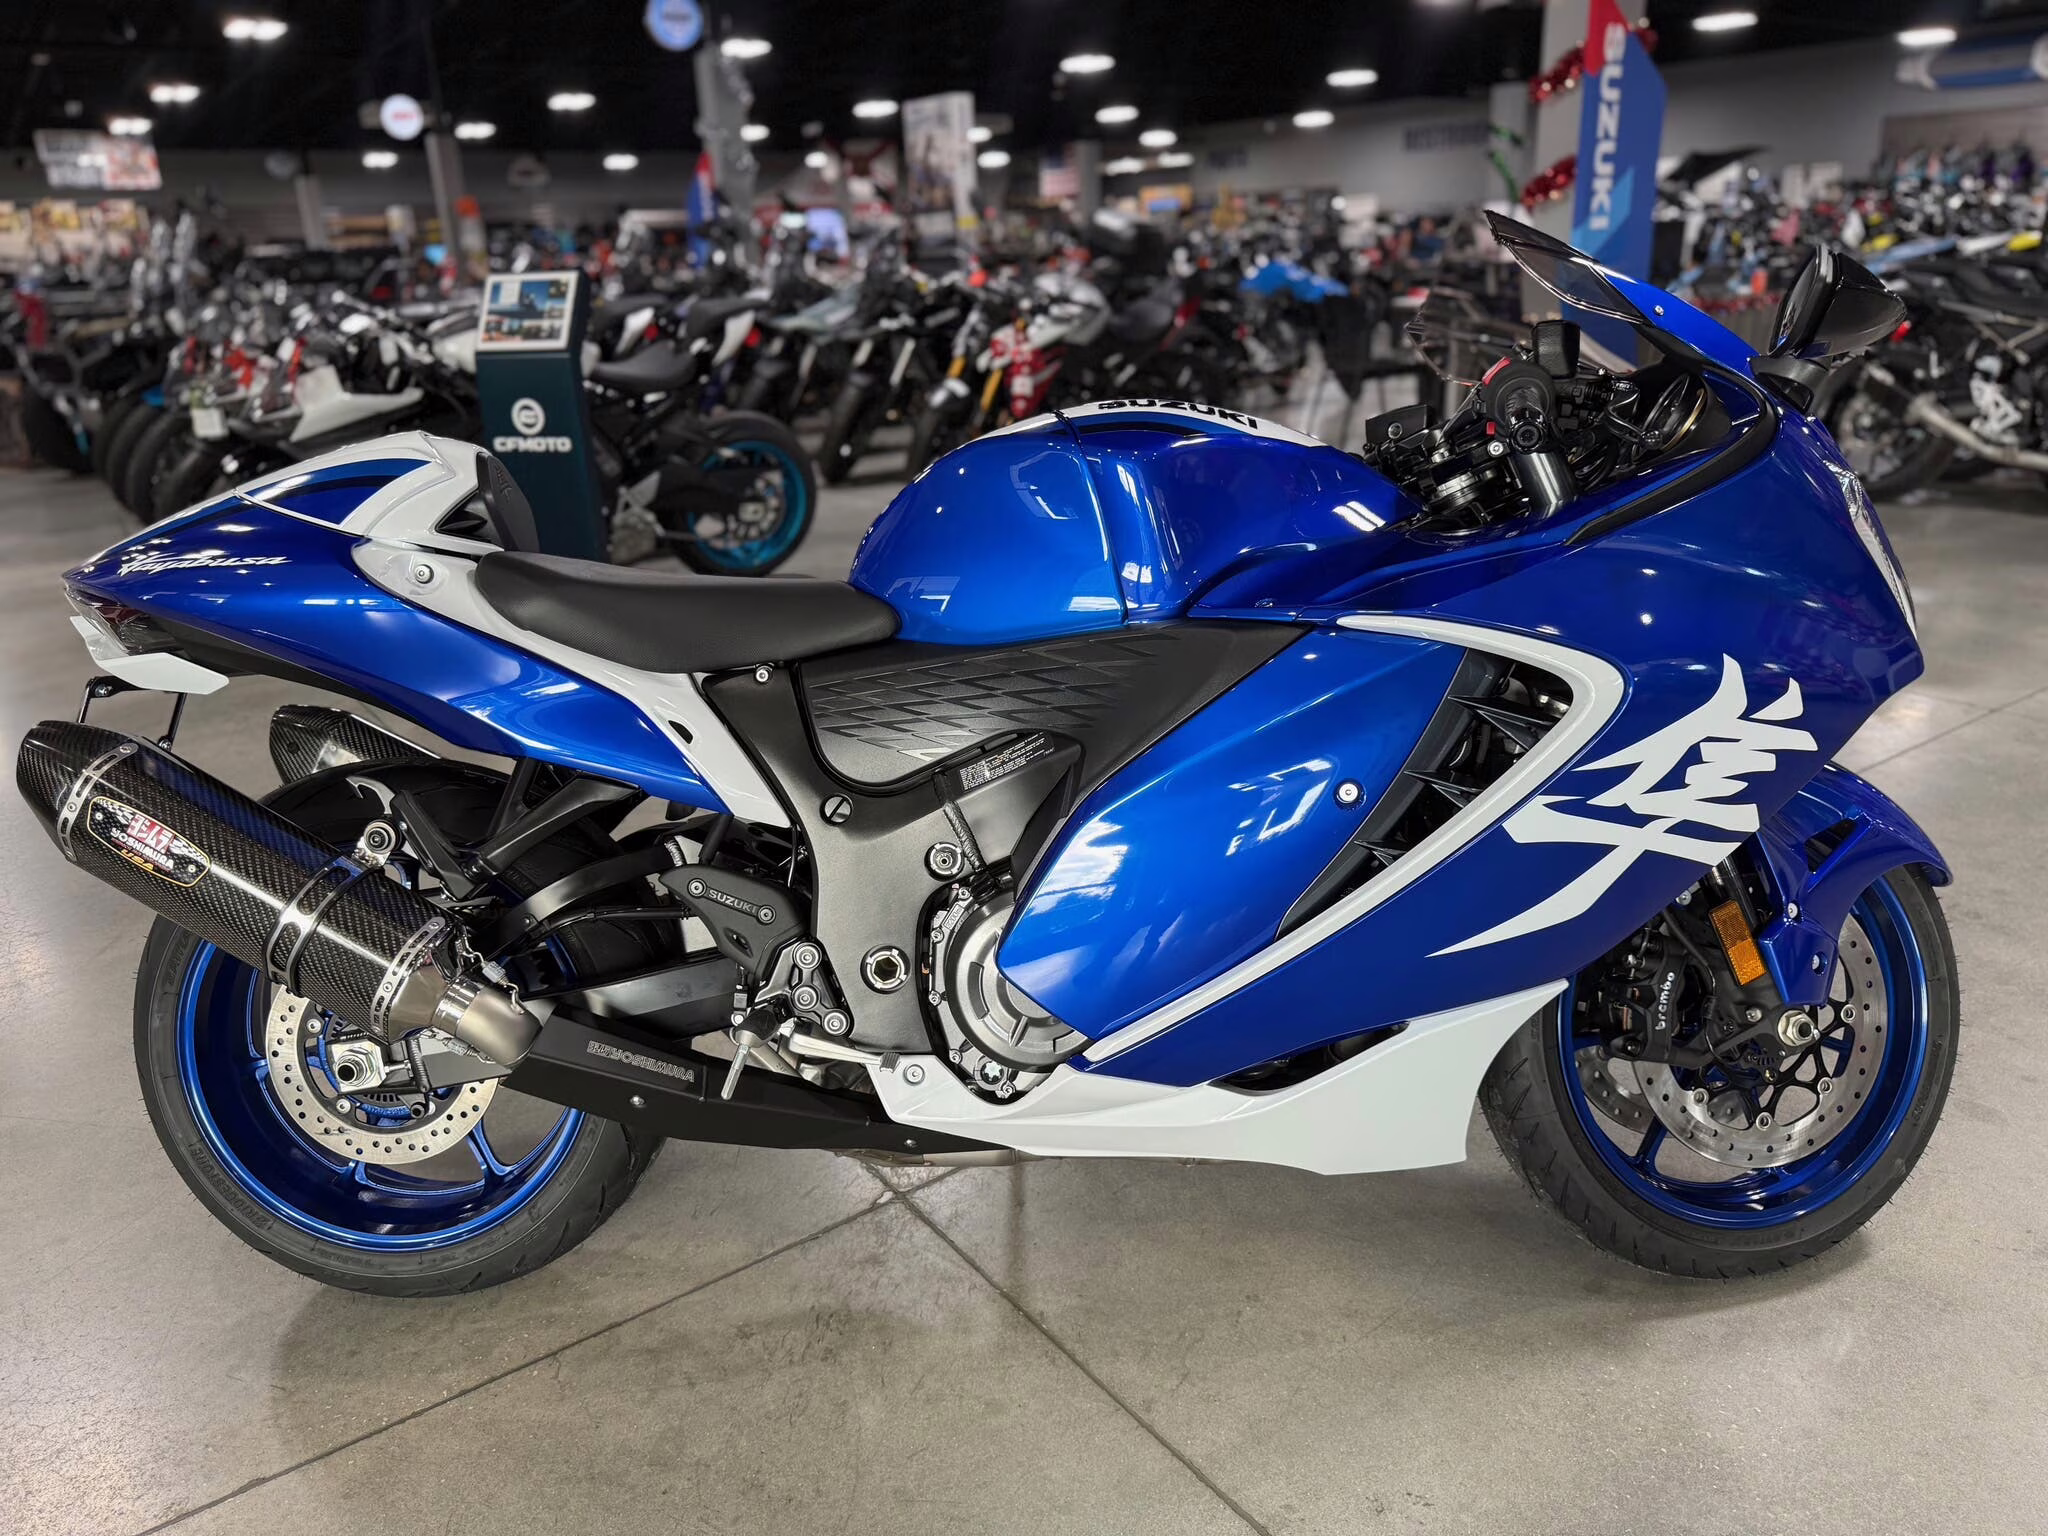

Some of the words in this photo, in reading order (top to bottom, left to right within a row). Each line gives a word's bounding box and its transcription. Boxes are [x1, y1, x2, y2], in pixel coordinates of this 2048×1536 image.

[1589, 22, 1626, 231] SUZUKI
[1098, 399, 1258, 430] SUZUKI
[493, 436, 572, 453] CFMOTO
[117, 551, 292, 577] Hayabusa
[110, 827, 174, 870] YOSHIMURA
[708, 889, 758, 914] SUZUKI
[1655, 972, 1675, 1030] brembo
[610, 1047, 695, 1083] YOSHIMURA
